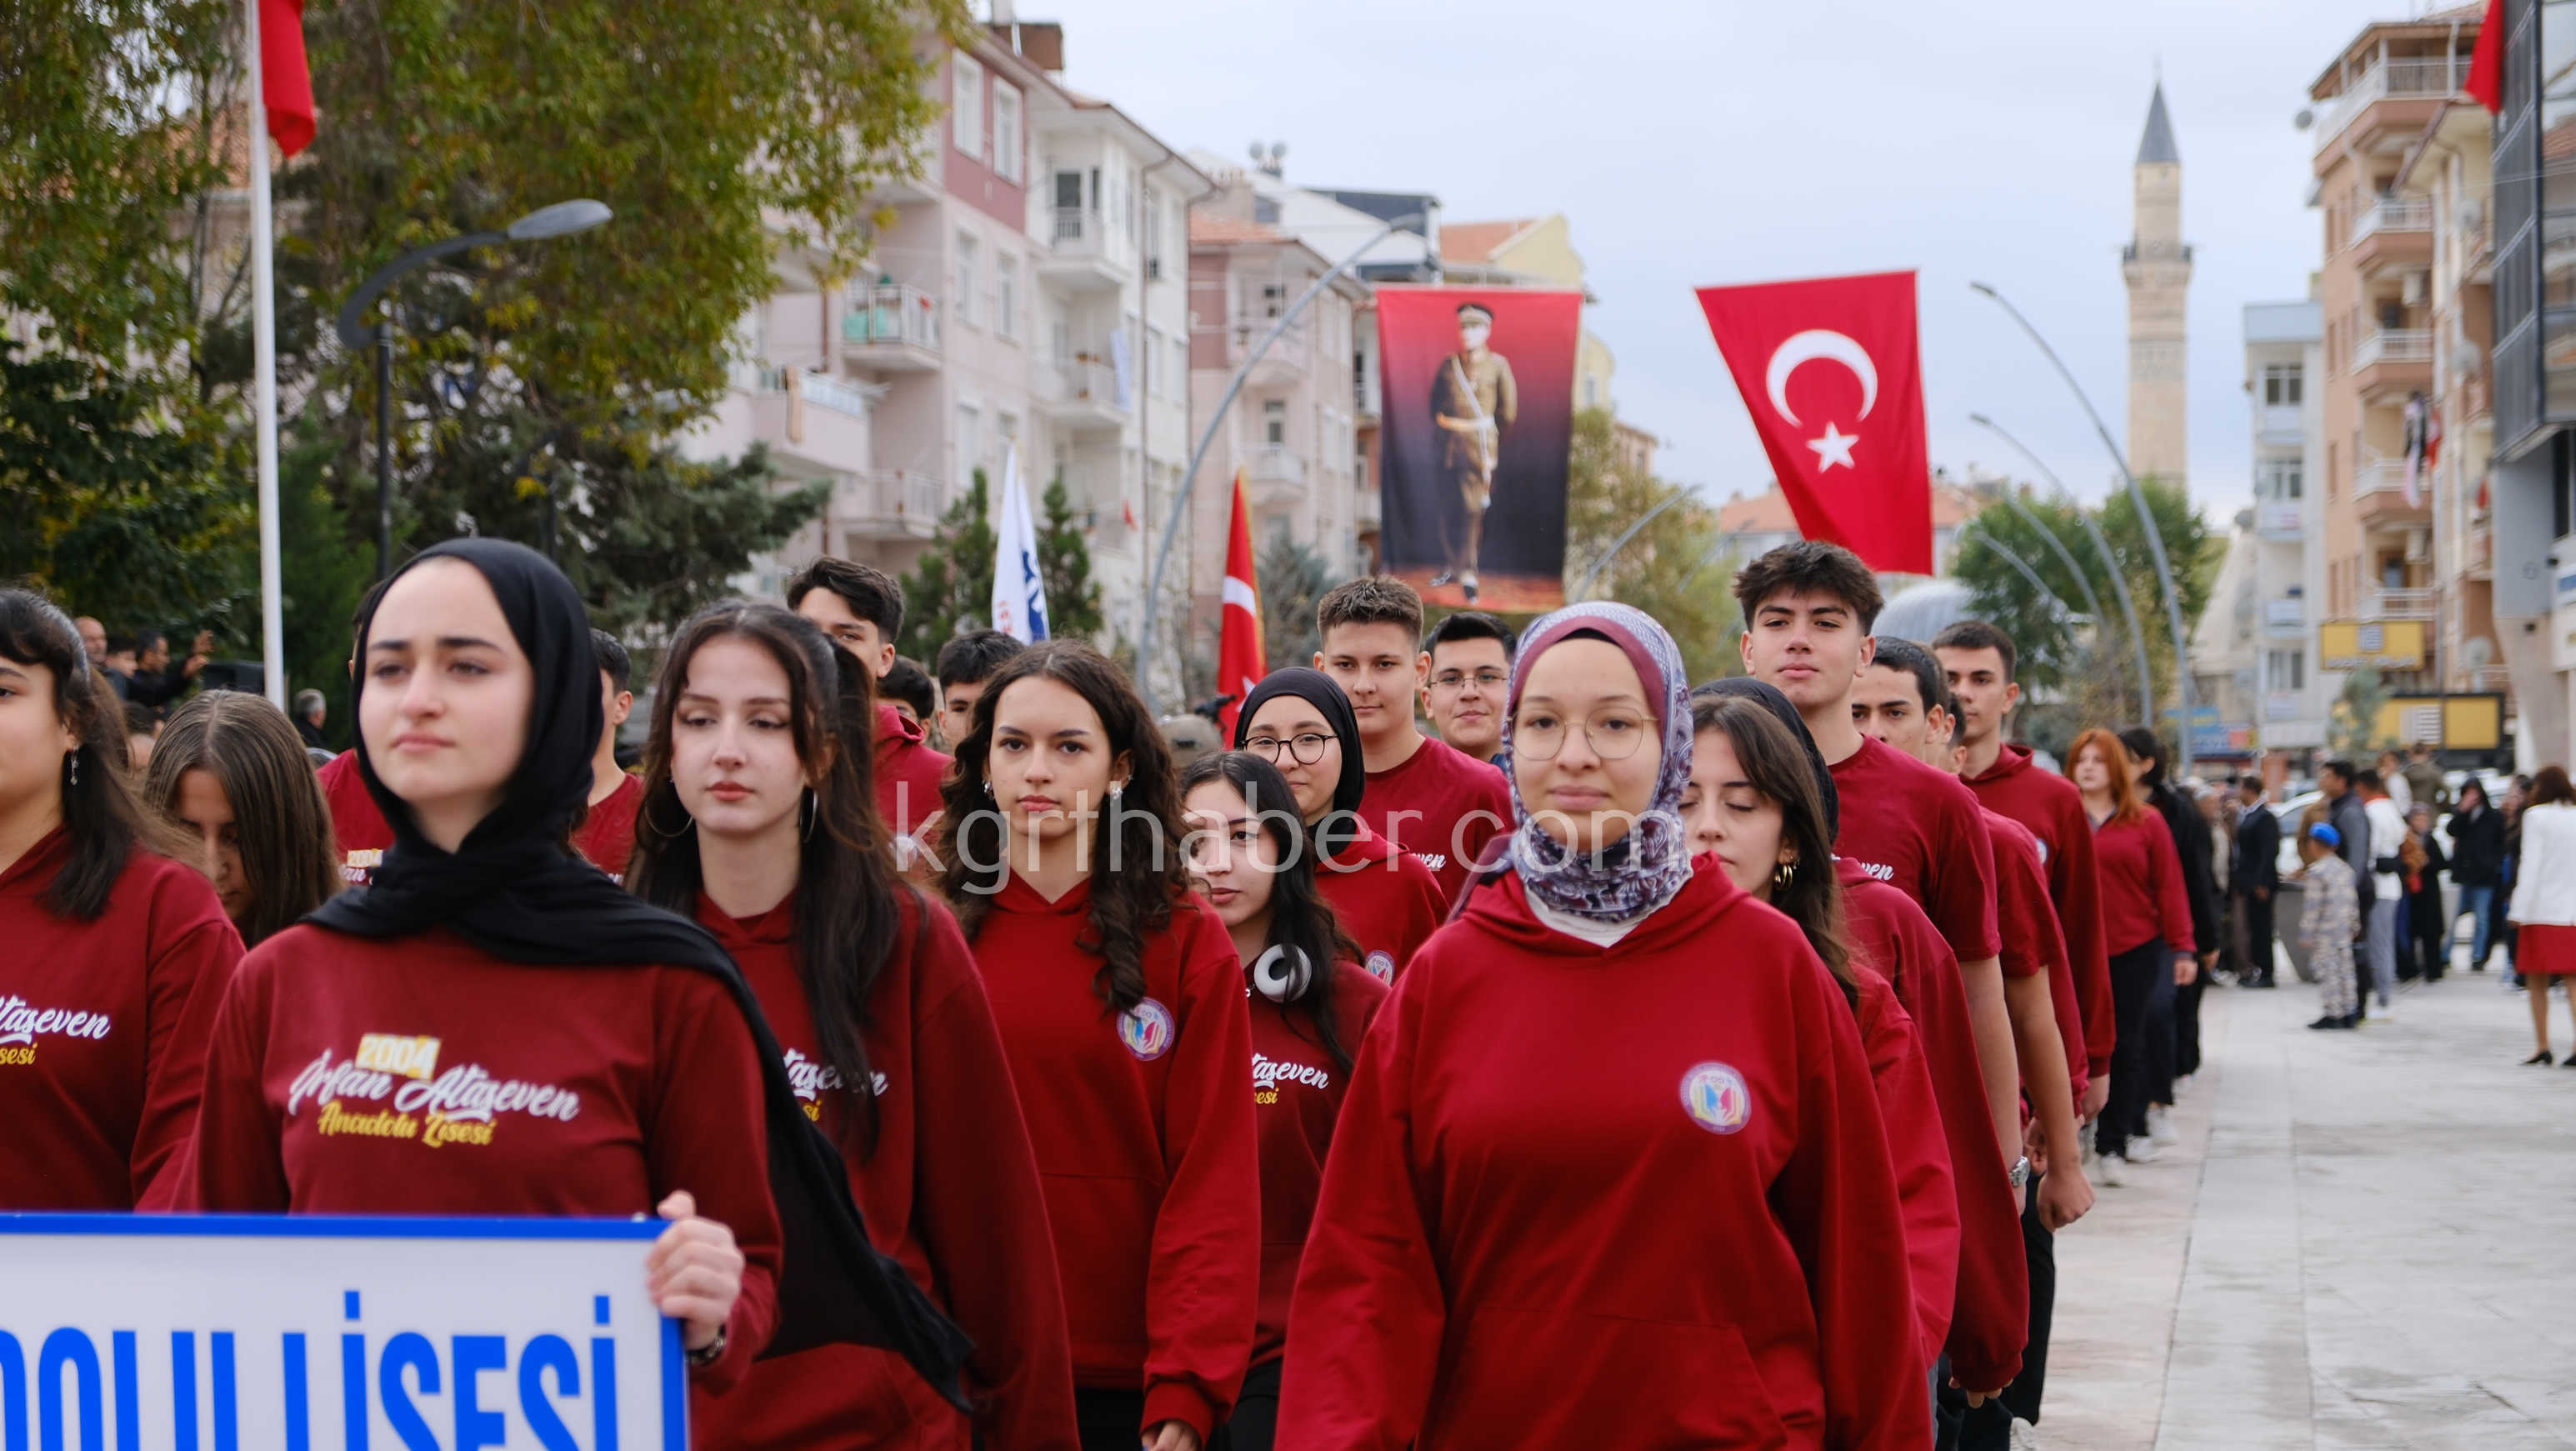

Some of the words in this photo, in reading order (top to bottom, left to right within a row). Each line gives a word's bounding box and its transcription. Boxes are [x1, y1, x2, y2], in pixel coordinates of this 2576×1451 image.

[0, 994, 111, 1044] taseven
[0, 1043, 38, 1065] sesi
[358, 1033, 440, 1080] 2004
[1252, 1053, 1329, 1089] taseven
[318, 1098, 418, 1138] Anadolu
